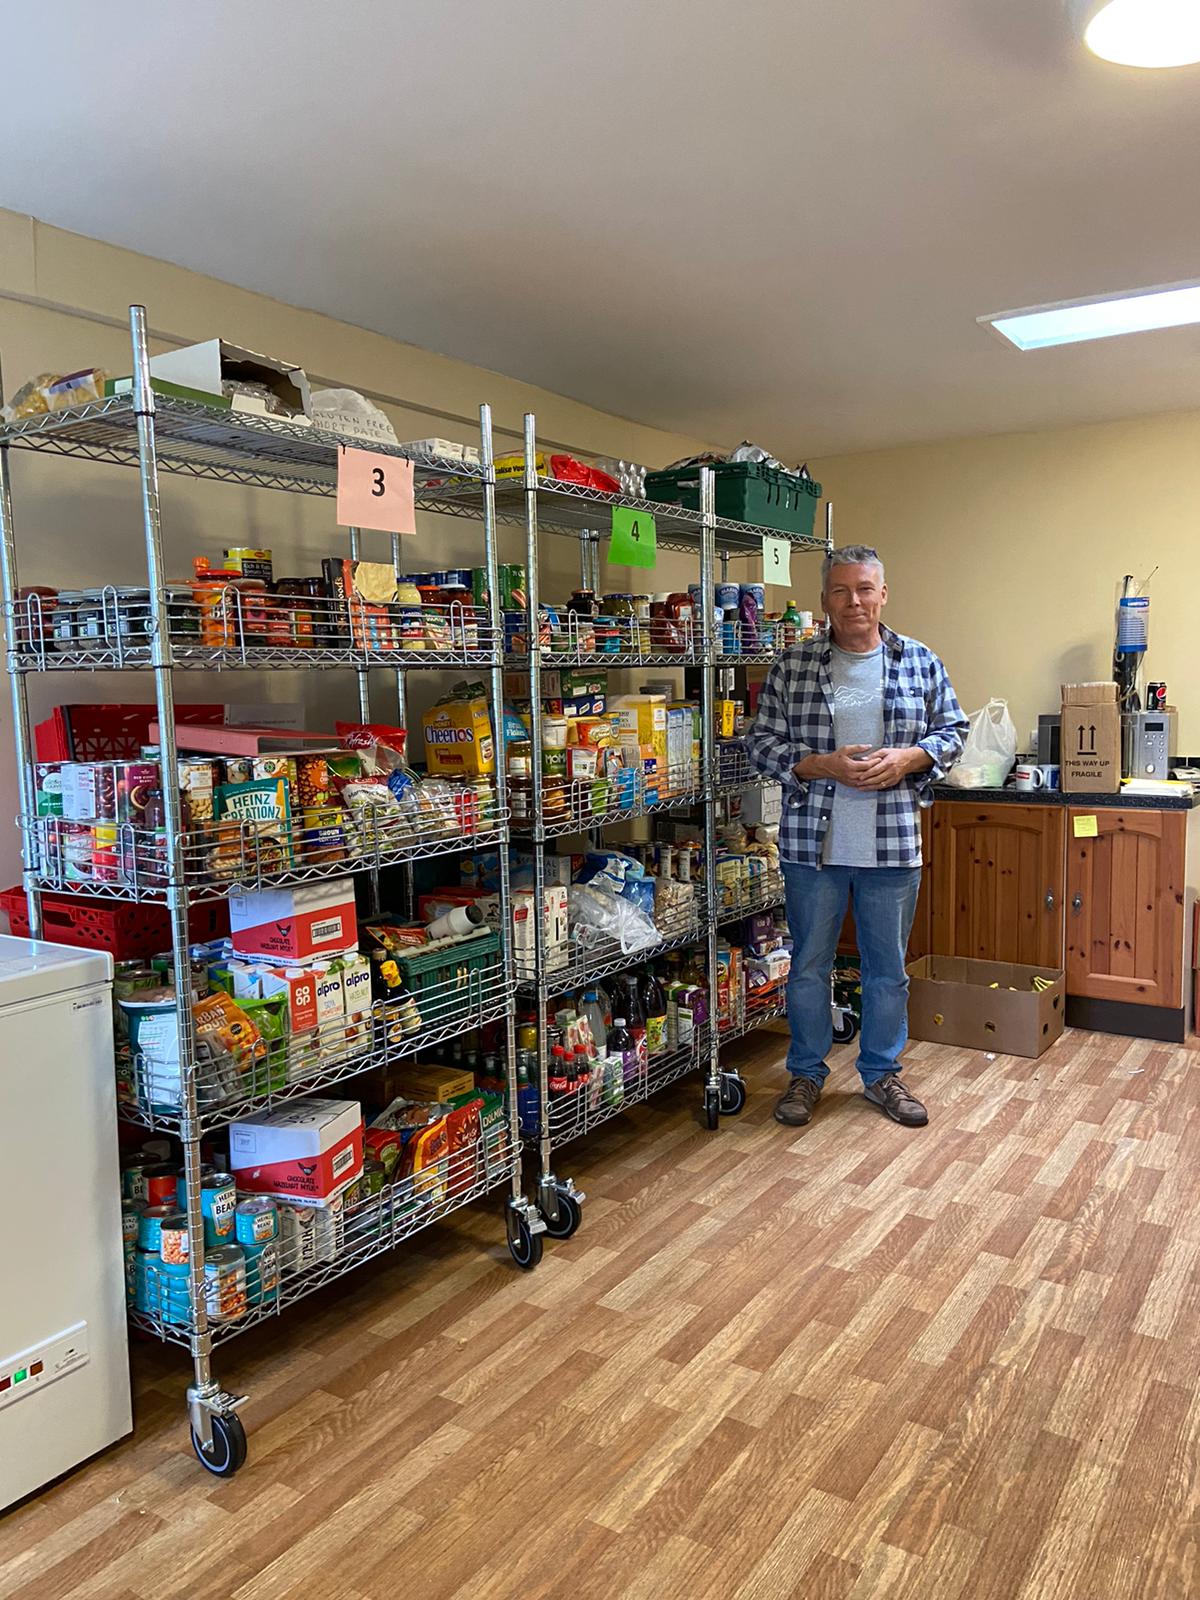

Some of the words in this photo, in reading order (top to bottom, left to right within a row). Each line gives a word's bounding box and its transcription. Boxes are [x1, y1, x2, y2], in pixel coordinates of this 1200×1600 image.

[371, 467, 386, 497] 3
[631, 520, 640, 542] 4
[773, 547, 780, 565] 5
[424, 725, 474, 745] Cheerios
[232, 793, 271, 810] HEINZ
[345, 972, 370, 987] alpro
[317, 981, 341, 997] alpro
[196, 1004, 225, 1025] RBAN
[286, 1175, 315, 1185] CHOCOLATE
[215, 1200, 236, 1215] BEAN
[256, 1213, 271, 1224] HEINZ
[256, 1220, 272, 1230] BEANZ
